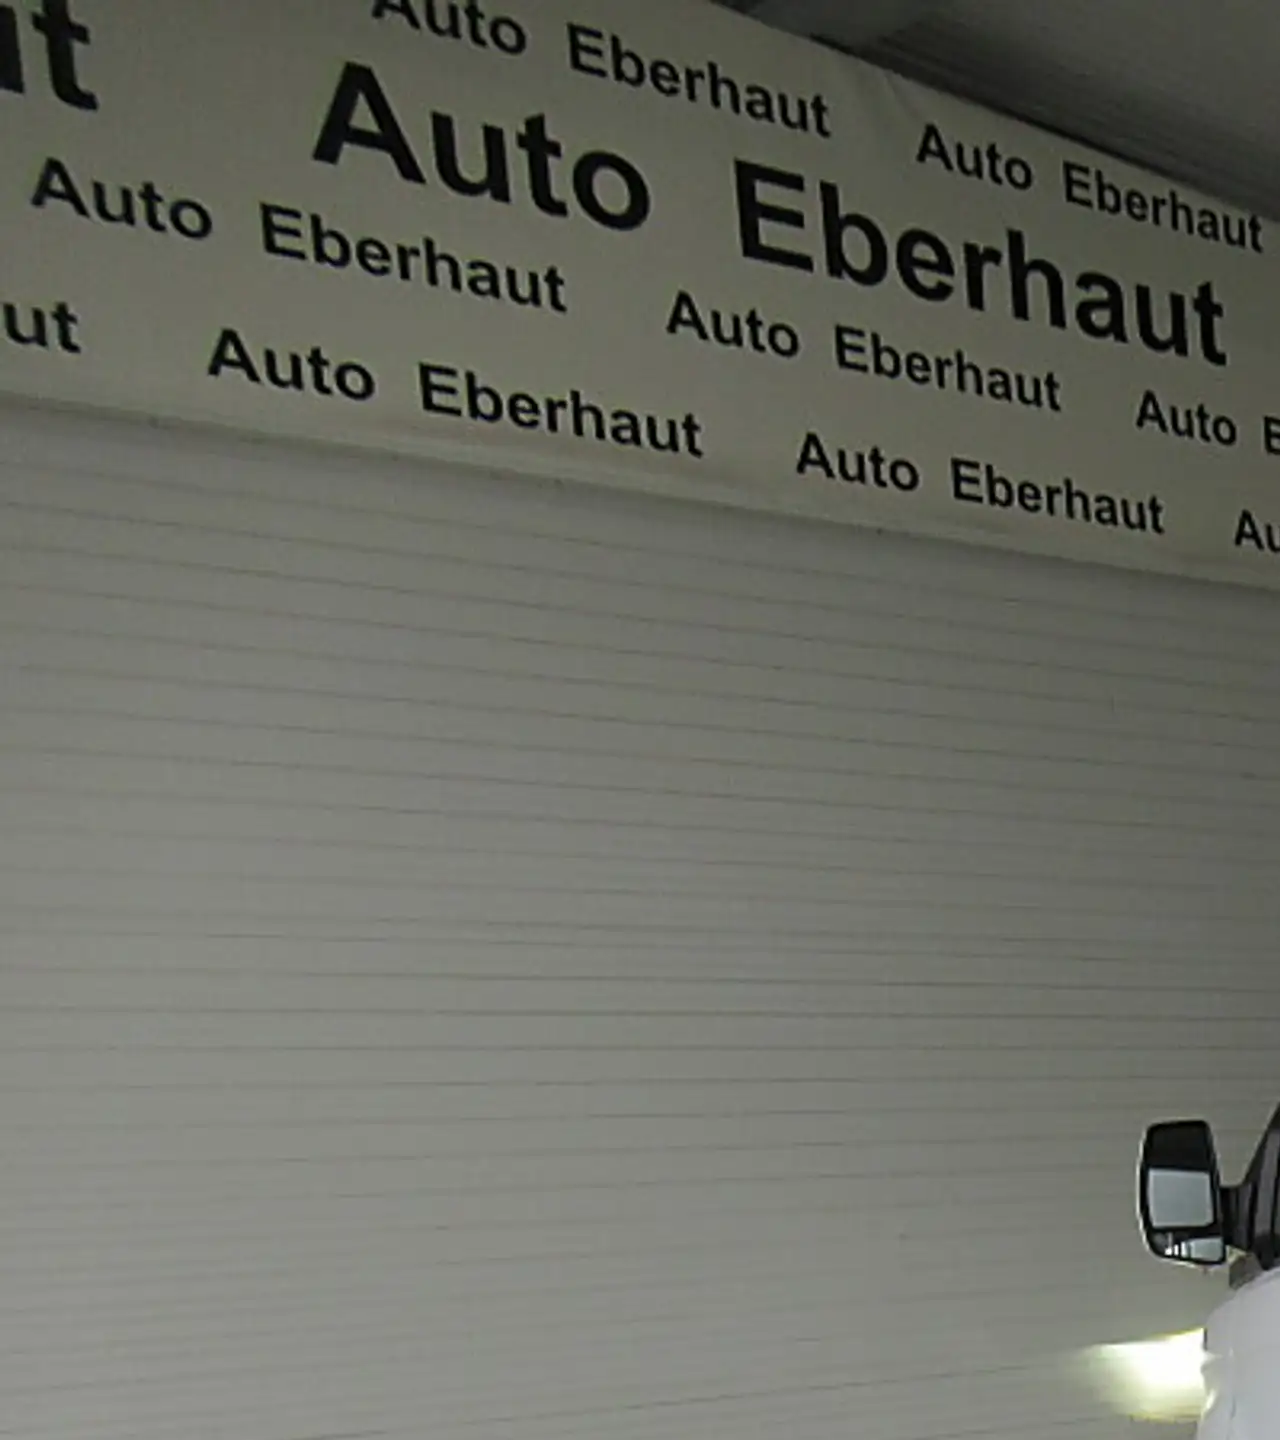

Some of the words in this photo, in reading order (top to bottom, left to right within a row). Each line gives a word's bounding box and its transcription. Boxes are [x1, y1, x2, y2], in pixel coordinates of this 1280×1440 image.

[567, 22, 830, 138] Eberhaut
[31, 157, 212, 240] Auto
[260, 202, 567, 312] Eberhaut
[312, 62, 650, 230] Auto
[734, 158, 1226, 366] Eberhaut
[917, 122, 1032, 192] Auto
[1062, 160, 1262, 254] Eberhaut
[207, 328, 375, 402] Auto
[418, 361, 703, 458] Eberhaut
[666, 291, 799, 358] Auto
[835, 324, 1061, 412] Eberhaut
[1136, 391, 1238, 446] Auto
[796, 433, 920, 491] Auto
[951, 457, 1164, 535] Eberhaut
